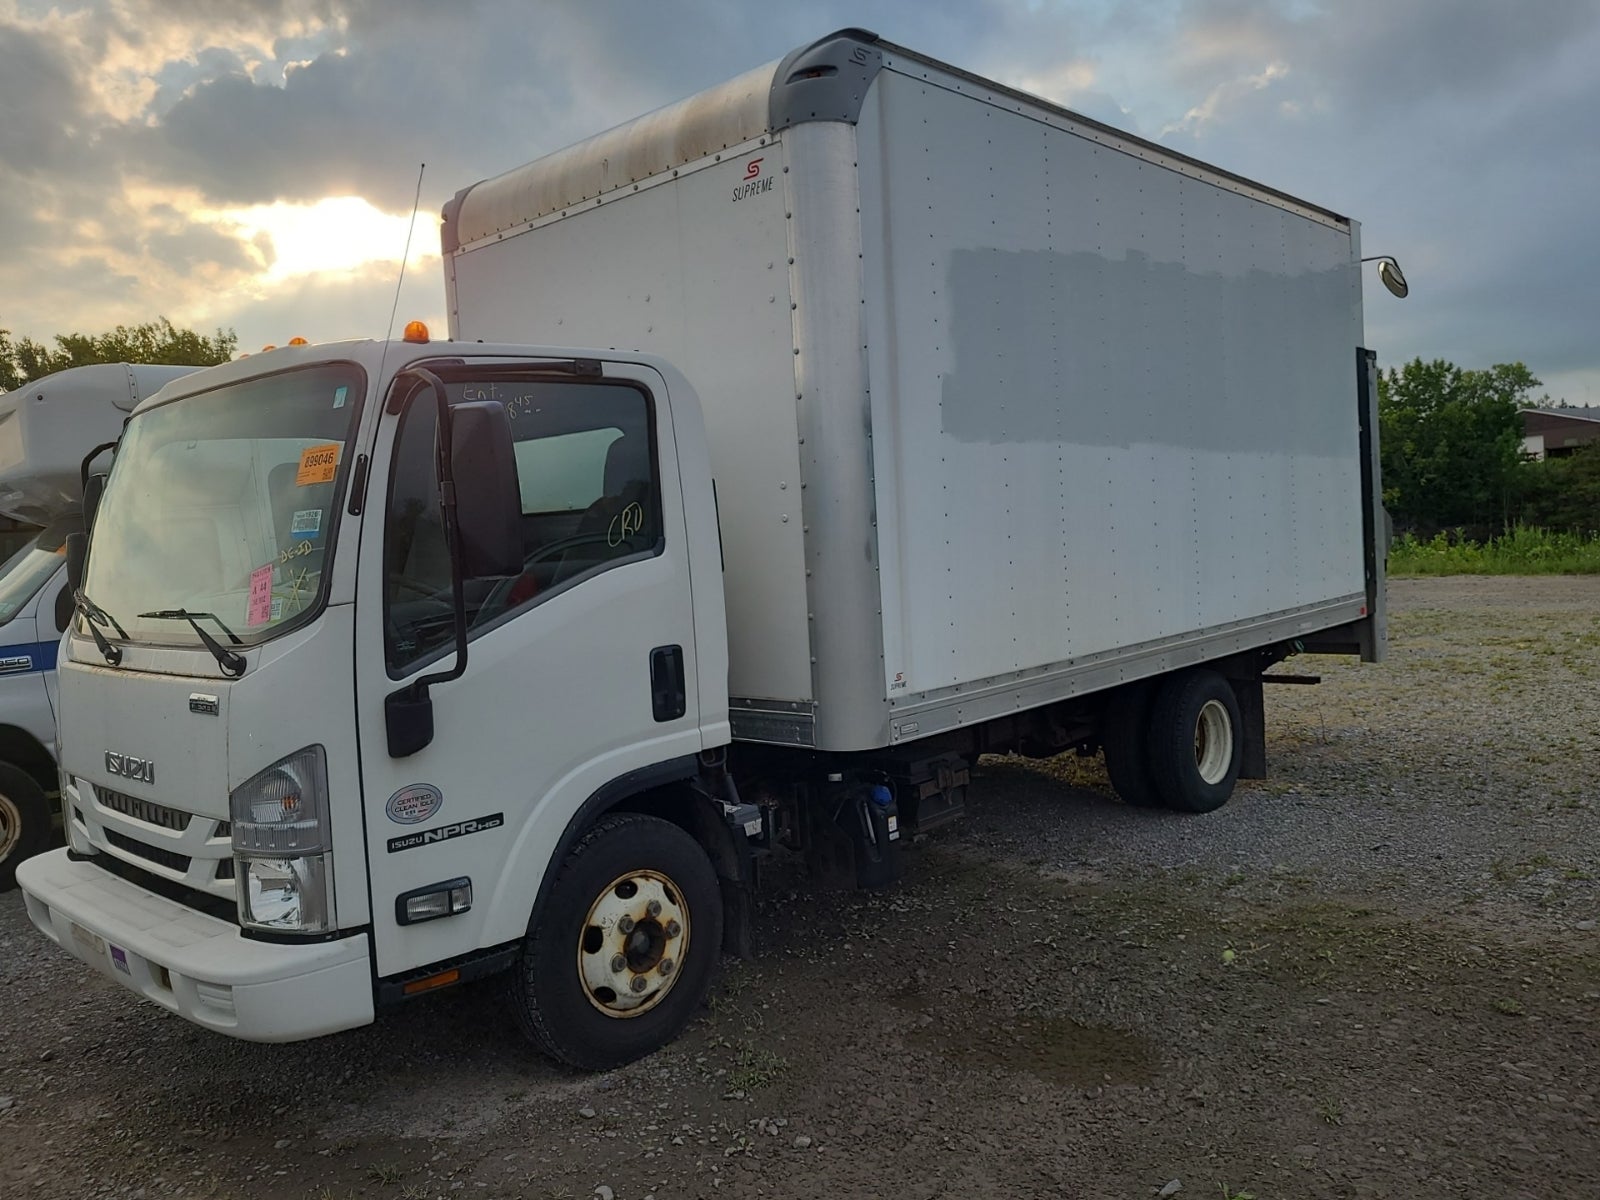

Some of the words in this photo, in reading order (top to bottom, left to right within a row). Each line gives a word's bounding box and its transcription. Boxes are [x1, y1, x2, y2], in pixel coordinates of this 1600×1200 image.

[732, 176, 773, 202] SUPREME
[304, 452, 334, 468] 899046
[104, 750, 154, 785] ISUZU
[394, 803, 417, 813] CLEAN
[420, 799, 435, 807] IDLE
[397, 793, 432, 806] CERTIFIED
[391, 836, 422, 849] ISUZU
[424, 820, 477, 843] NPR
